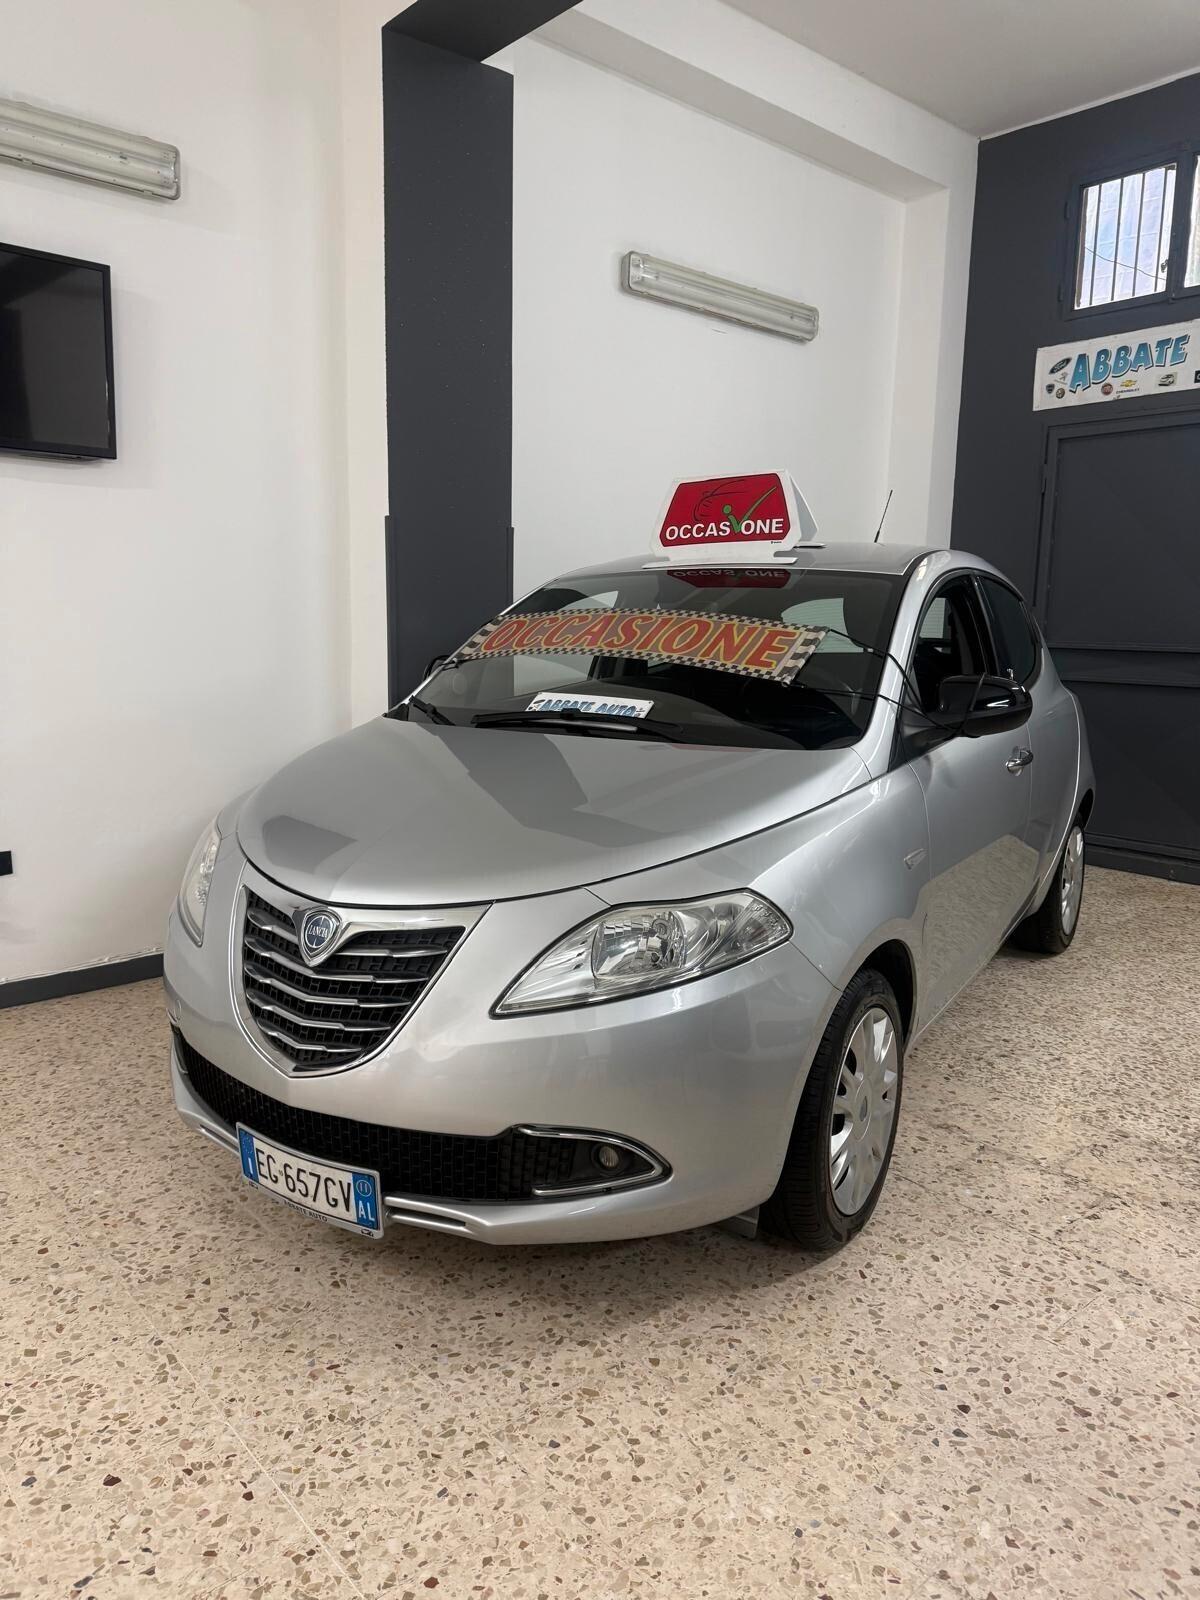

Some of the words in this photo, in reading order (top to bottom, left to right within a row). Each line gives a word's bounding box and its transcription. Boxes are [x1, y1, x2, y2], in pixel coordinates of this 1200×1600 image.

[1069, 334, 1191, 394] ABBATE
[481, 613, 800, 670] OCCASIONE
[595, 702, 637, 717] AUTO
[358, 1200, 376, 1222] AL
